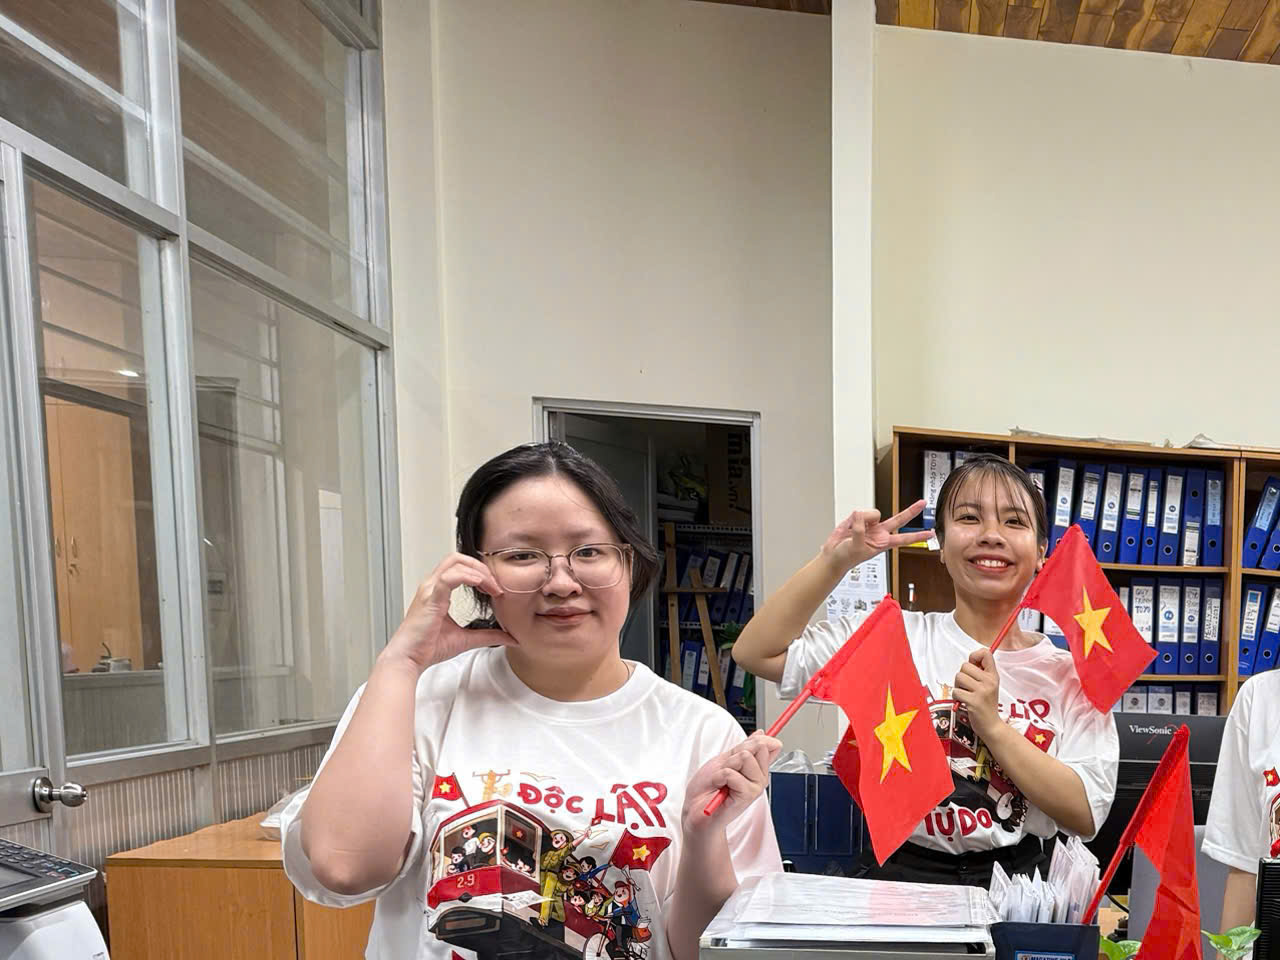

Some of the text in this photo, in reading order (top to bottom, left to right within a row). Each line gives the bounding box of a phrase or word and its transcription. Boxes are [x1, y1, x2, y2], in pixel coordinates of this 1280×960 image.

[1129, 724, 1172, 735] ViewSonic
[517, 781, 668, 830] ĐỘC LẬP
[957, 808, 993, 836] DO
